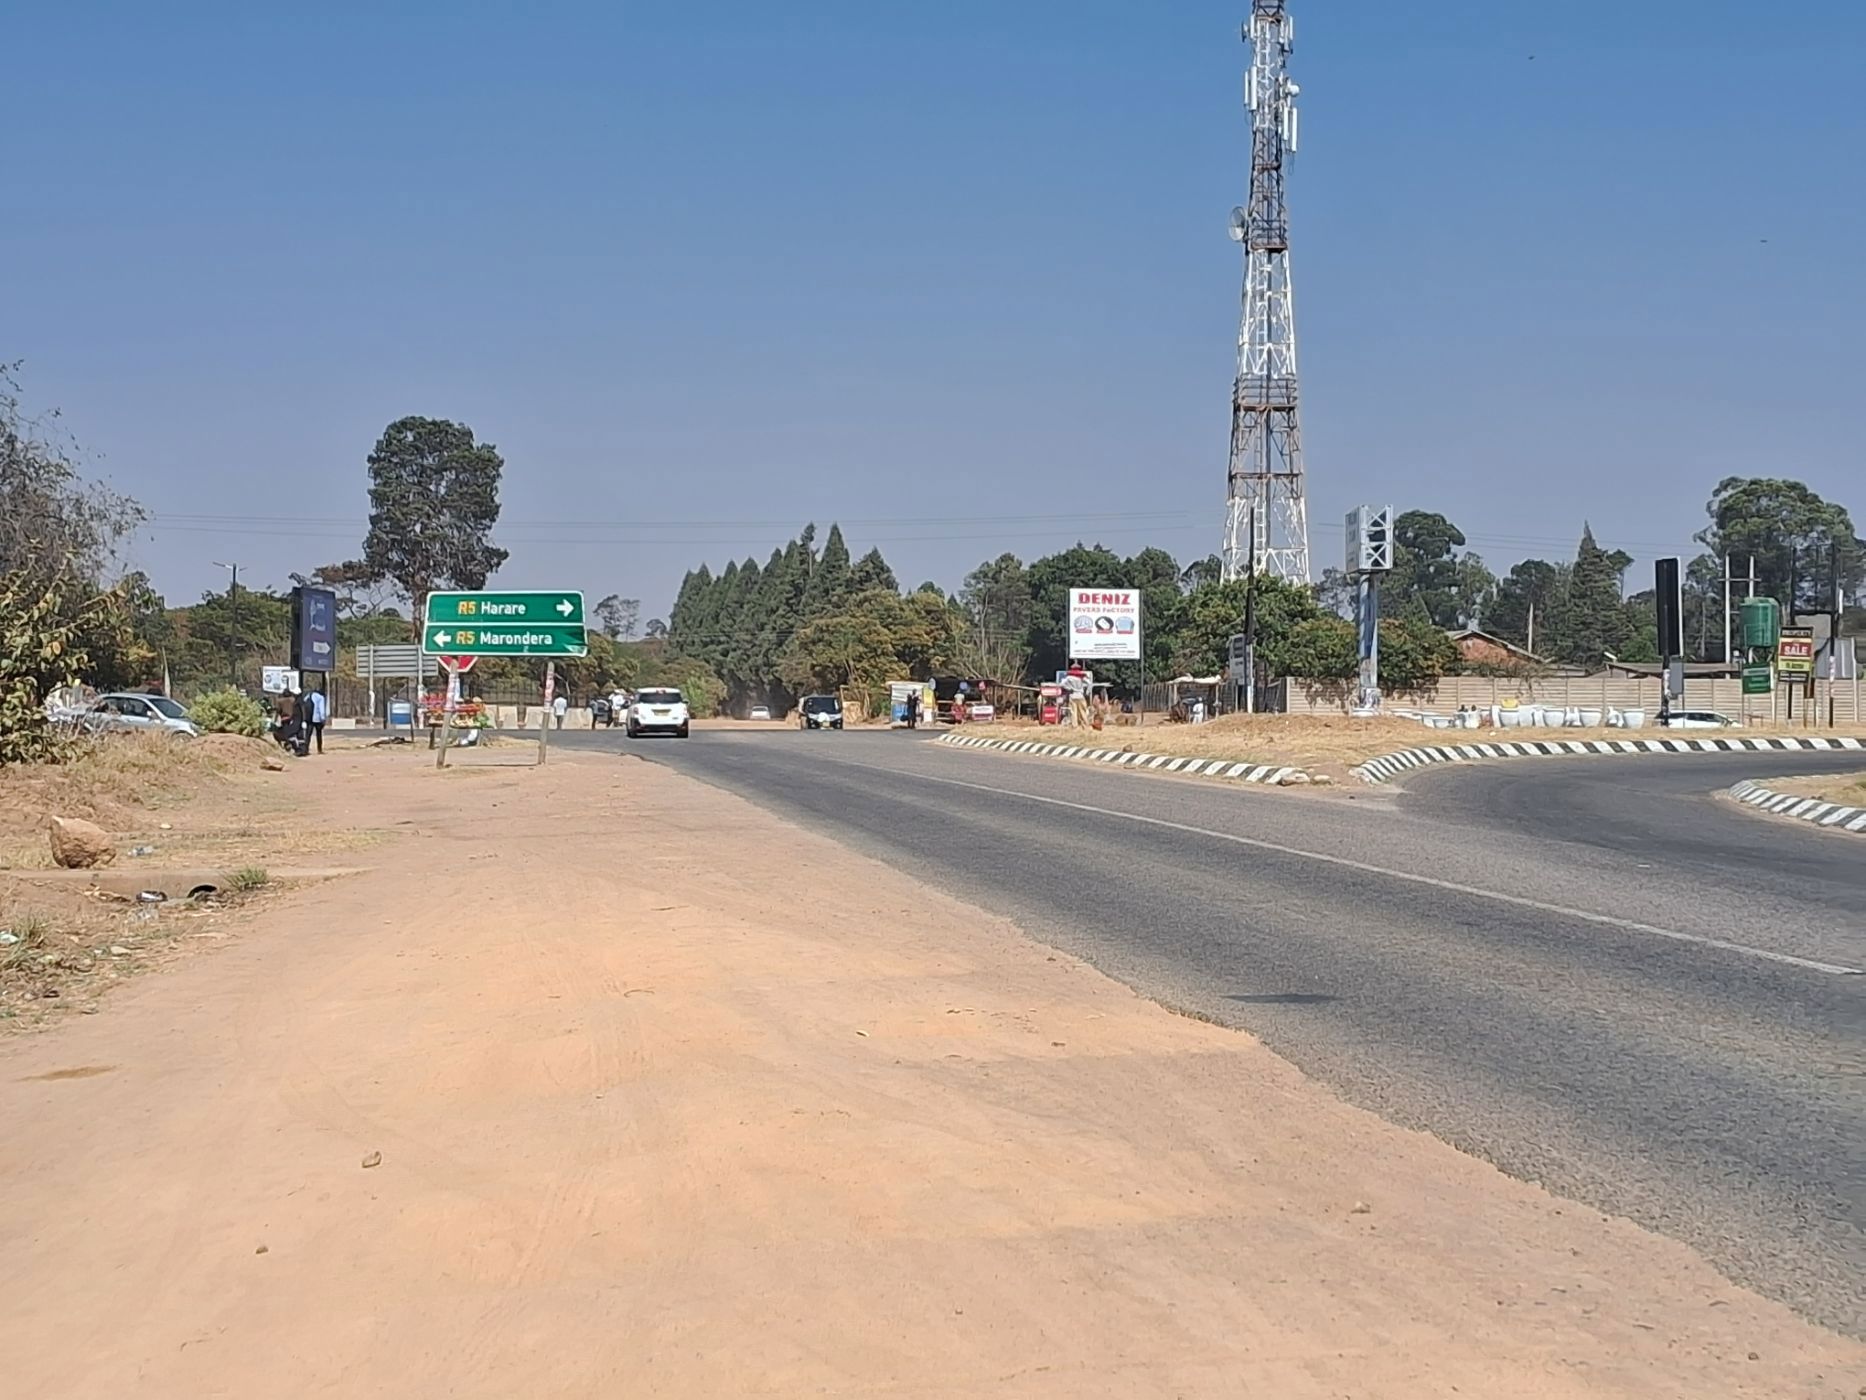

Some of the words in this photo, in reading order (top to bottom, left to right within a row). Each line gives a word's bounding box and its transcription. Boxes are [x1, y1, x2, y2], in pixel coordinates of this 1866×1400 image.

[1078, 593, 1130, 605] DENIZ
[458, 602, 476, 614] R5
[481, 602, 526, 615] Harare
[456, 632, 475, 644] R5
[480, 631, 553, 645] Marondera
[1784, 646, 1808, 656] SALE
